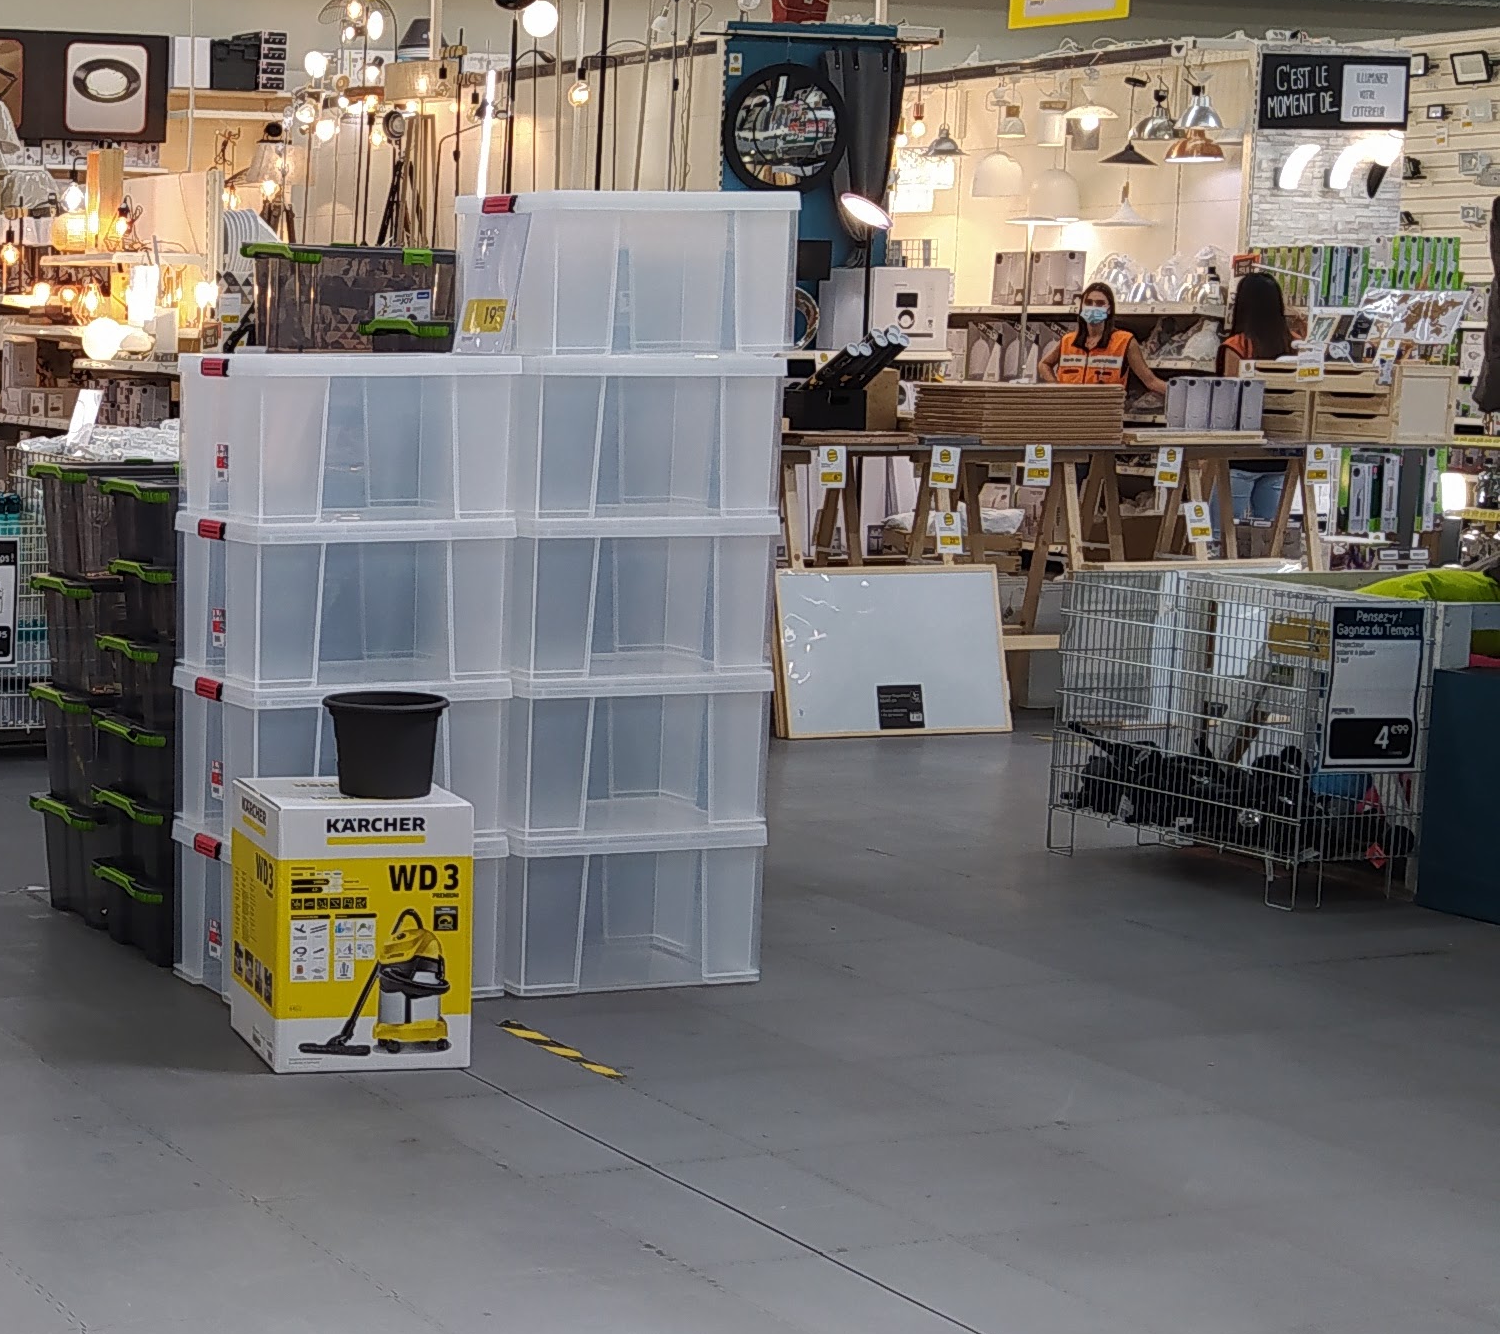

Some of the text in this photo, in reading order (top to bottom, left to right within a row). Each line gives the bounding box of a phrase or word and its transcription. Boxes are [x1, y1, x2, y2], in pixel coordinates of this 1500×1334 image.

[1276, 64, 1329, 92] C'EST LE
[1268, 93, 1316, 119] MOMENT
[1356, 610, 1398, 624] Pensez-y
[1336, 623, 1370, 637] Gagnez
[1372, 623, 1383, 635] du
[1385, 624, 1414, 637] Temps
[326, 816, 426, 833] KÄRCHER
[389, 864, 438, 892] WD
[443, 863, 459, 891] 3
